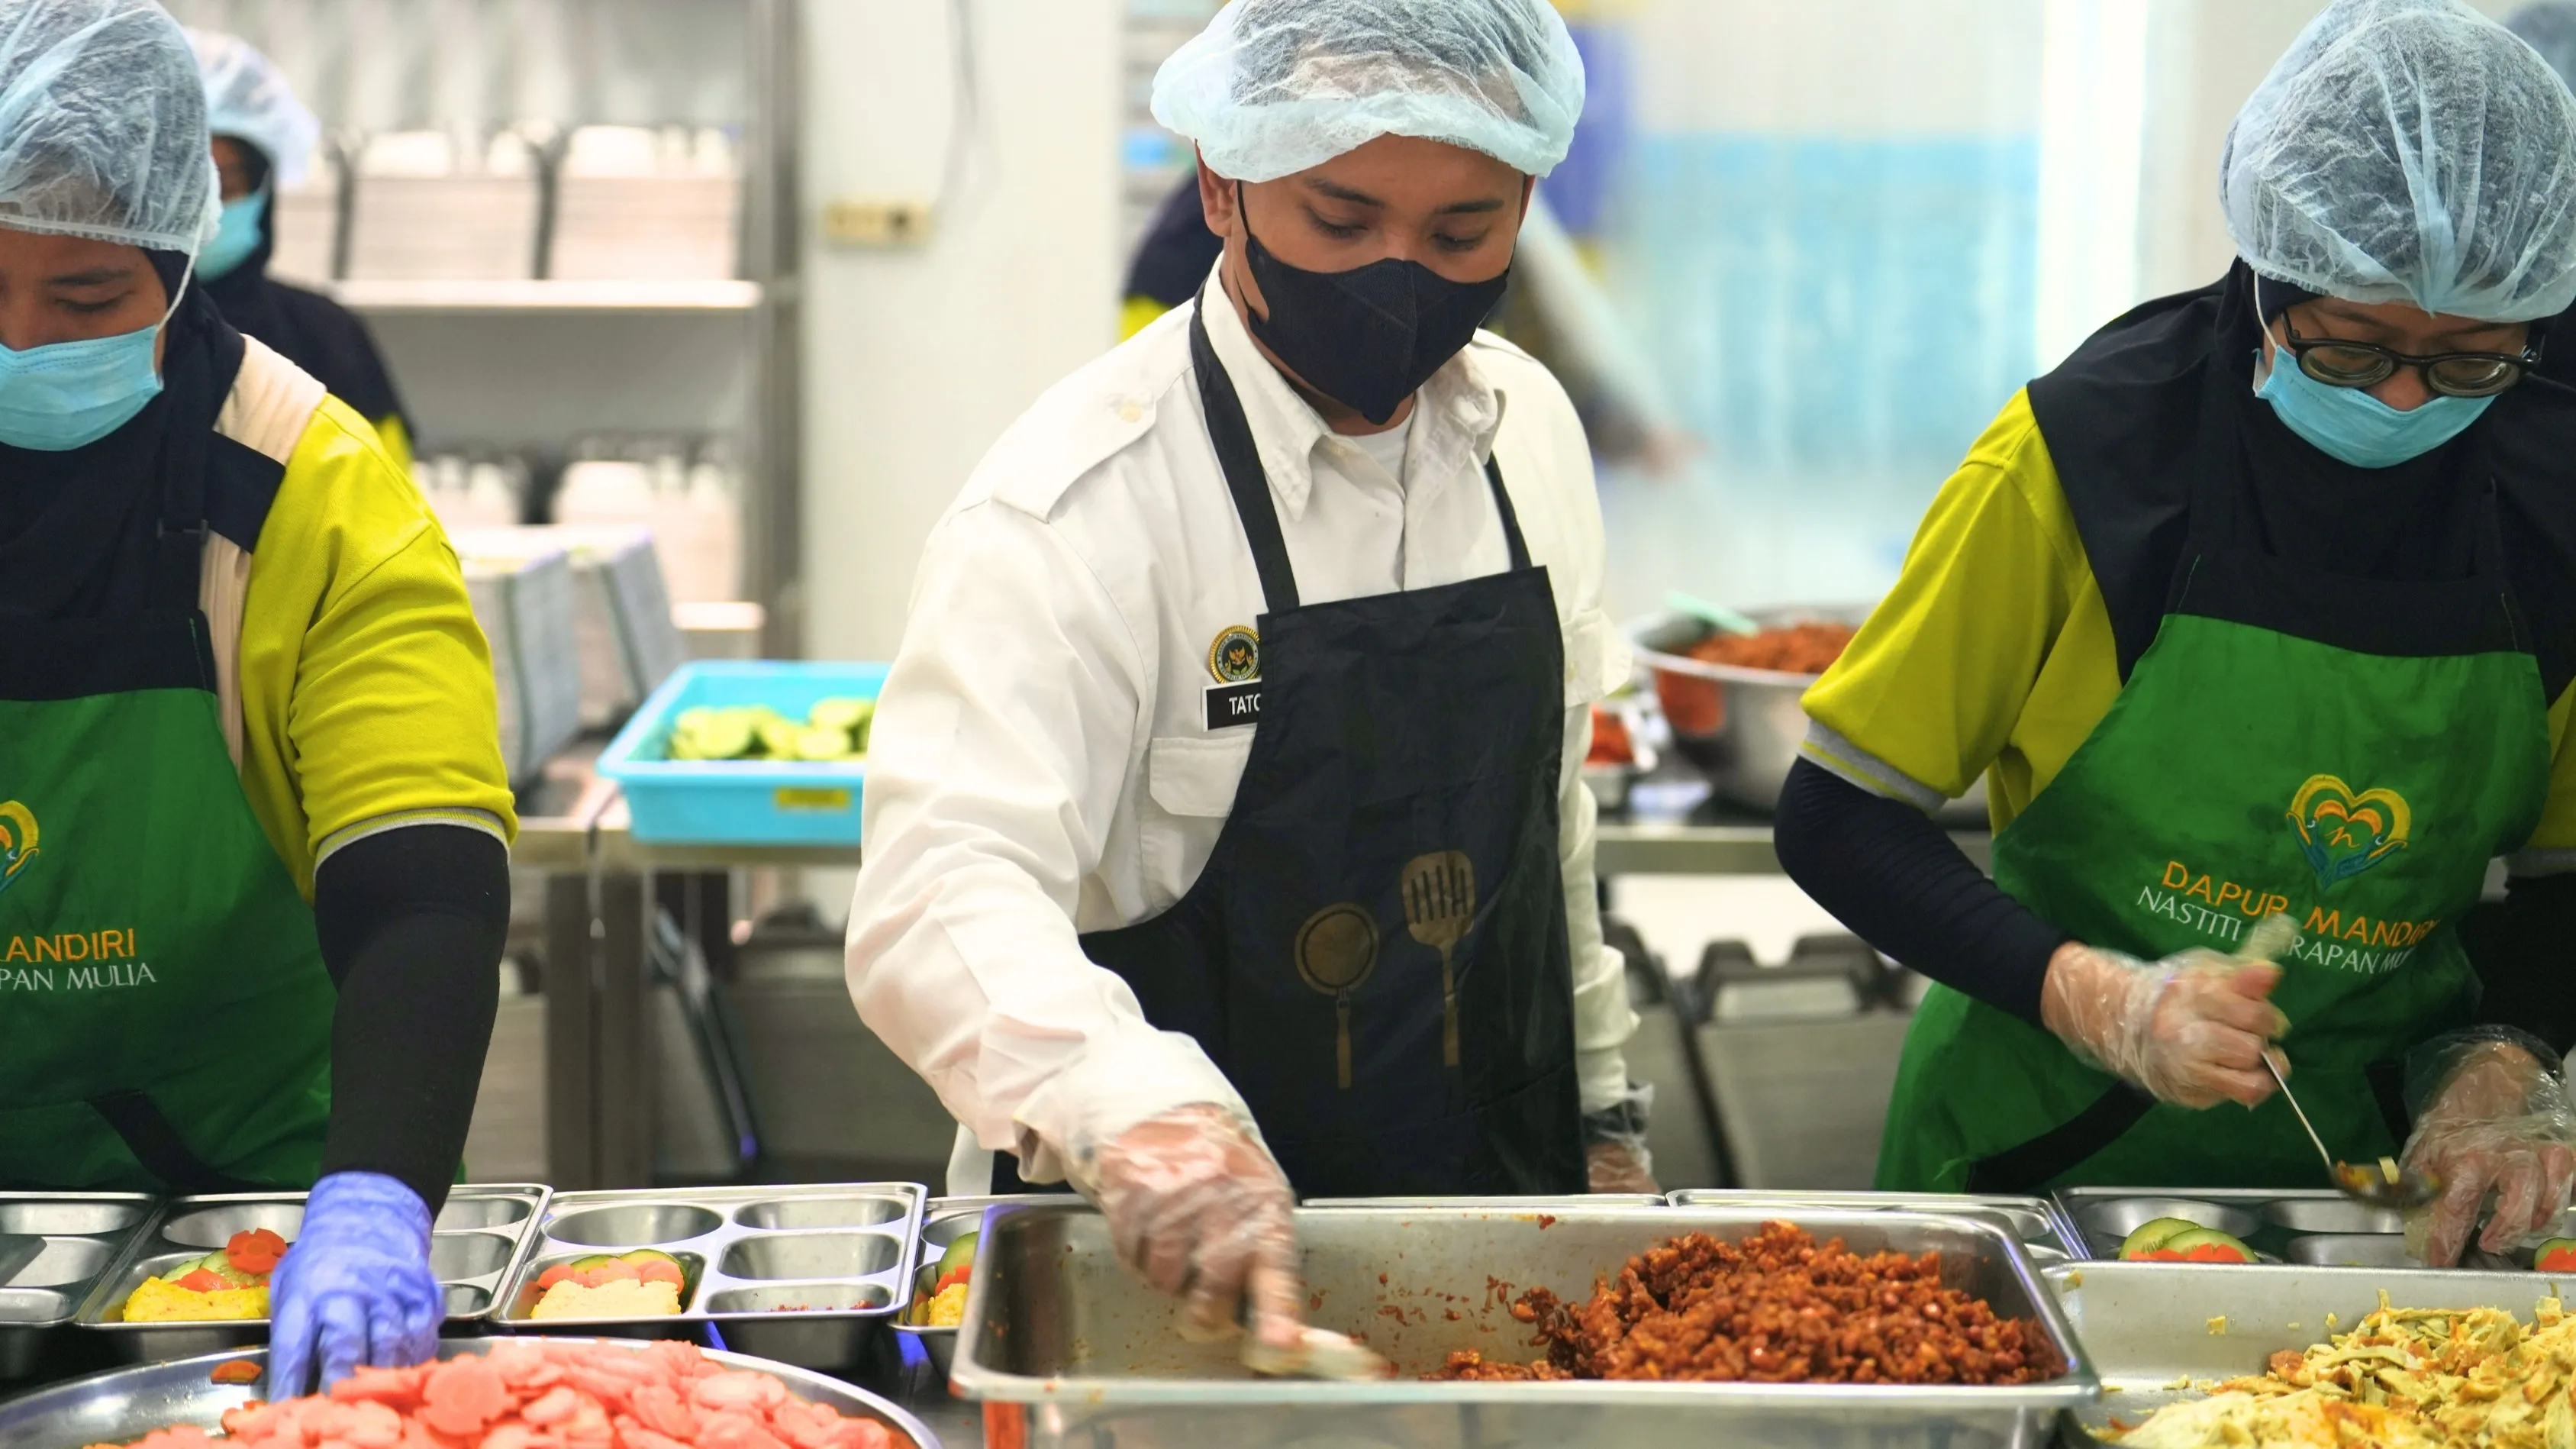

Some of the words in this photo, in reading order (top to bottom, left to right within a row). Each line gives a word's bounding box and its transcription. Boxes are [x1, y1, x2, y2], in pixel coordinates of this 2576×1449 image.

[2136, 885, 2242, 942] NASTITI
[4, 928, 136, 963] ANDIRI
[66, 962, 158, 990] MULIA
